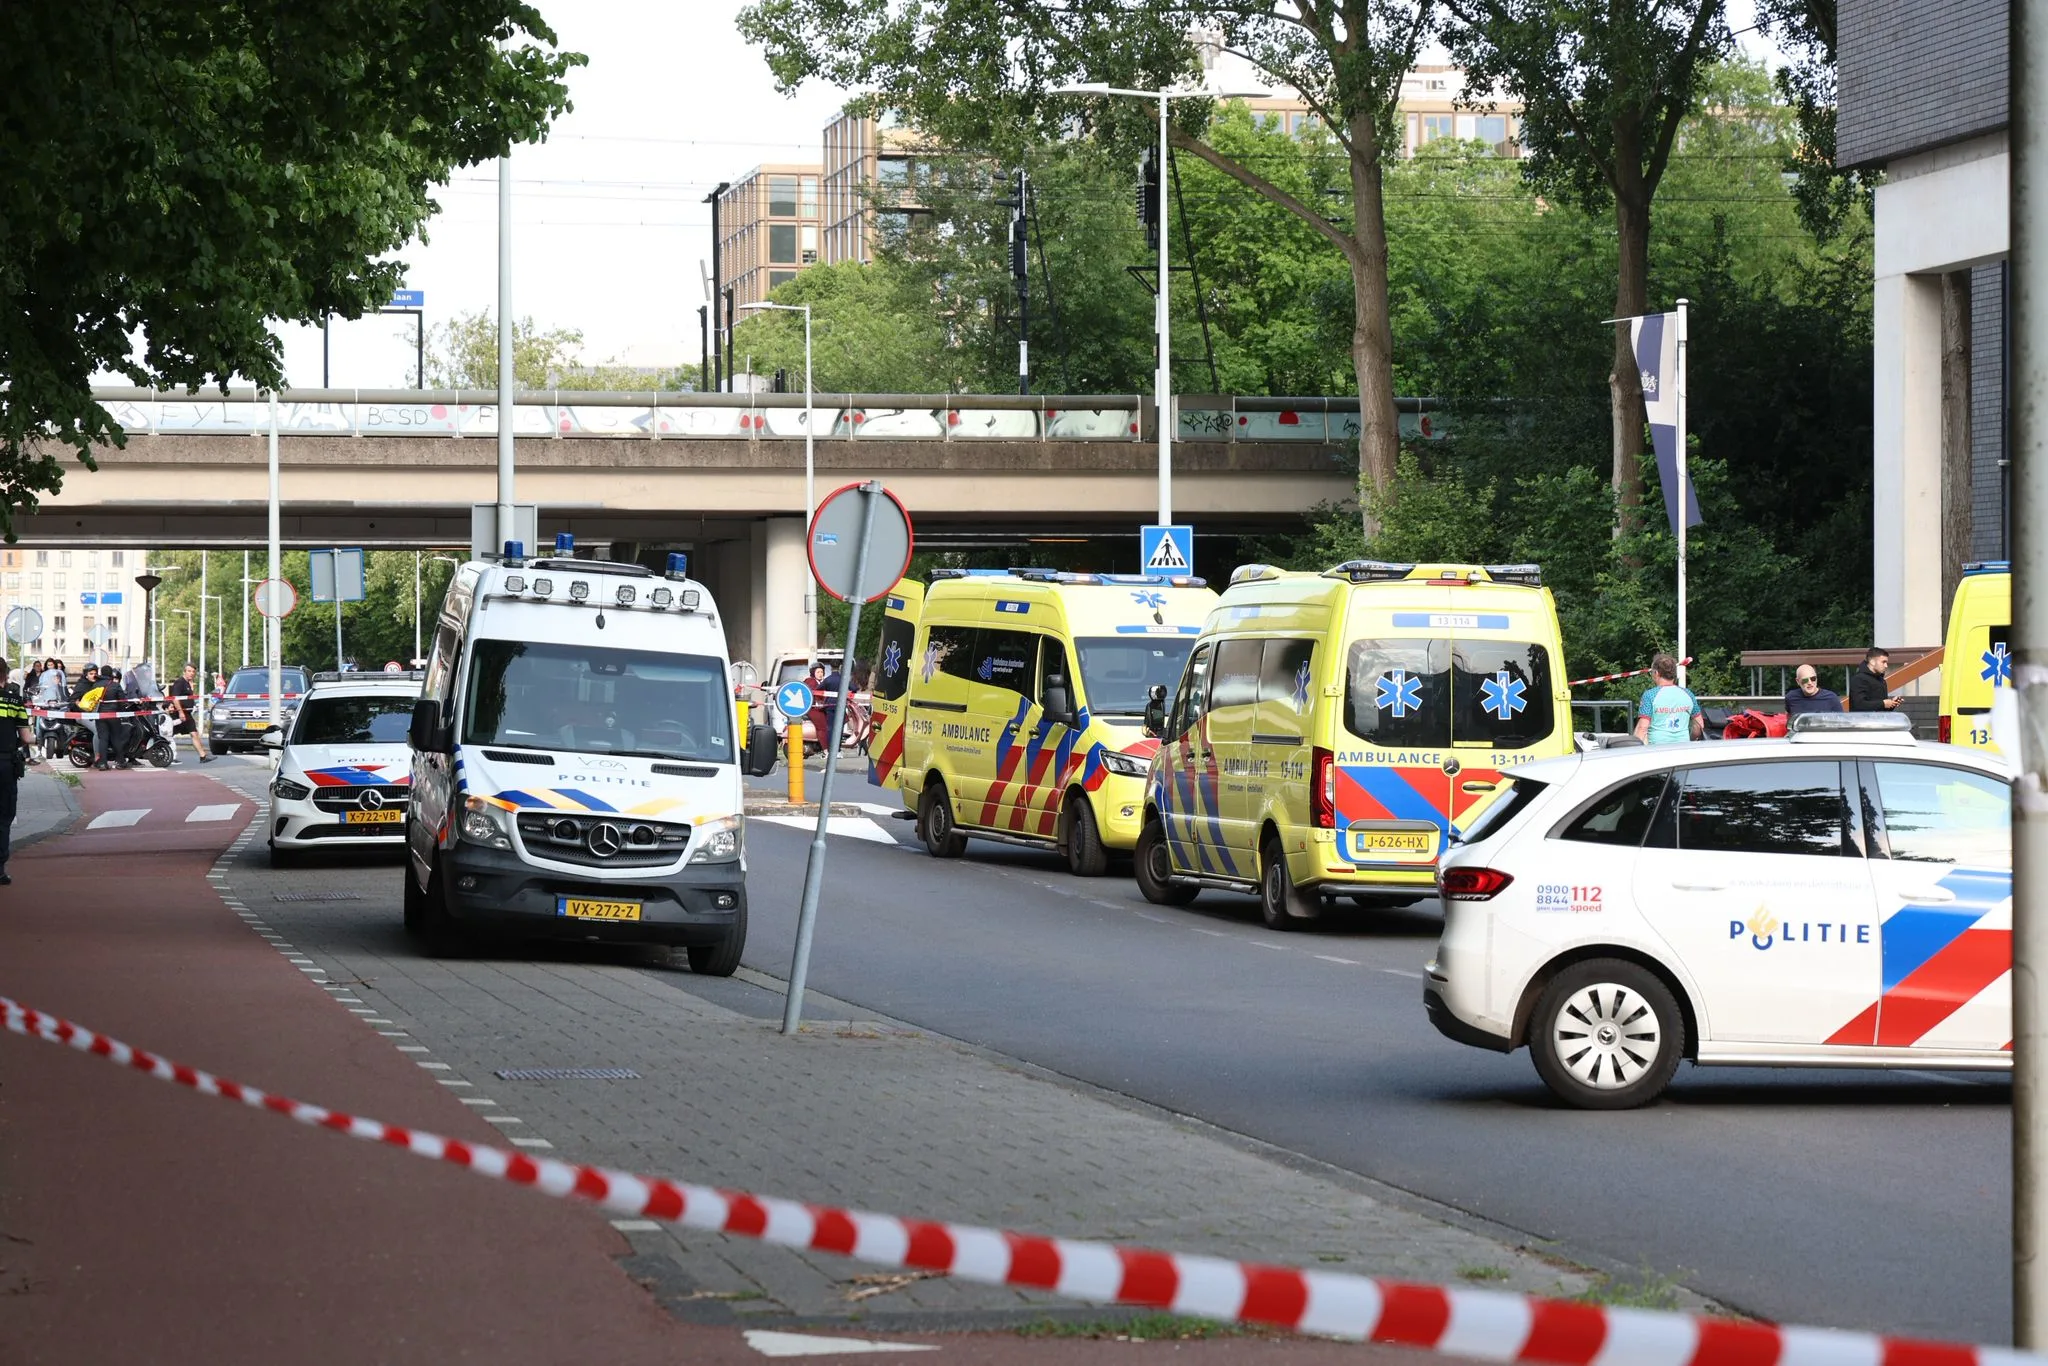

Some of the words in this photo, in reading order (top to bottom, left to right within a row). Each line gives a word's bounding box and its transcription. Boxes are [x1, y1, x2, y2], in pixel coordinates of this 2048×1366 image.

[912, 720, 933, 735] 13-156
[941, 723, 990, 742] AMBULANCE
[1969, 729, 1992, 745] 13-
[1336, 751, 1441, 765] AMBULANCE
[1224, 758, 1268, 778] AMBULANCE
[1280, 760, 1303, 779] 13-114
[558, 774, 652, 788] POLITIE
[350, 811, 397, 822] X-722-VB
[1367, 836, 1425, 849] J-626-HX
[1536, 884, 1569, 894] 0900
[1571, 886, 1602, 902] 112
[1536, 895, 1568, 904] 8844
[572, 902, 634, 918] VX-272-Z
[1570, 904, 1602, 914] spoed
[1729, 920, 1870, 951] POLITIE
